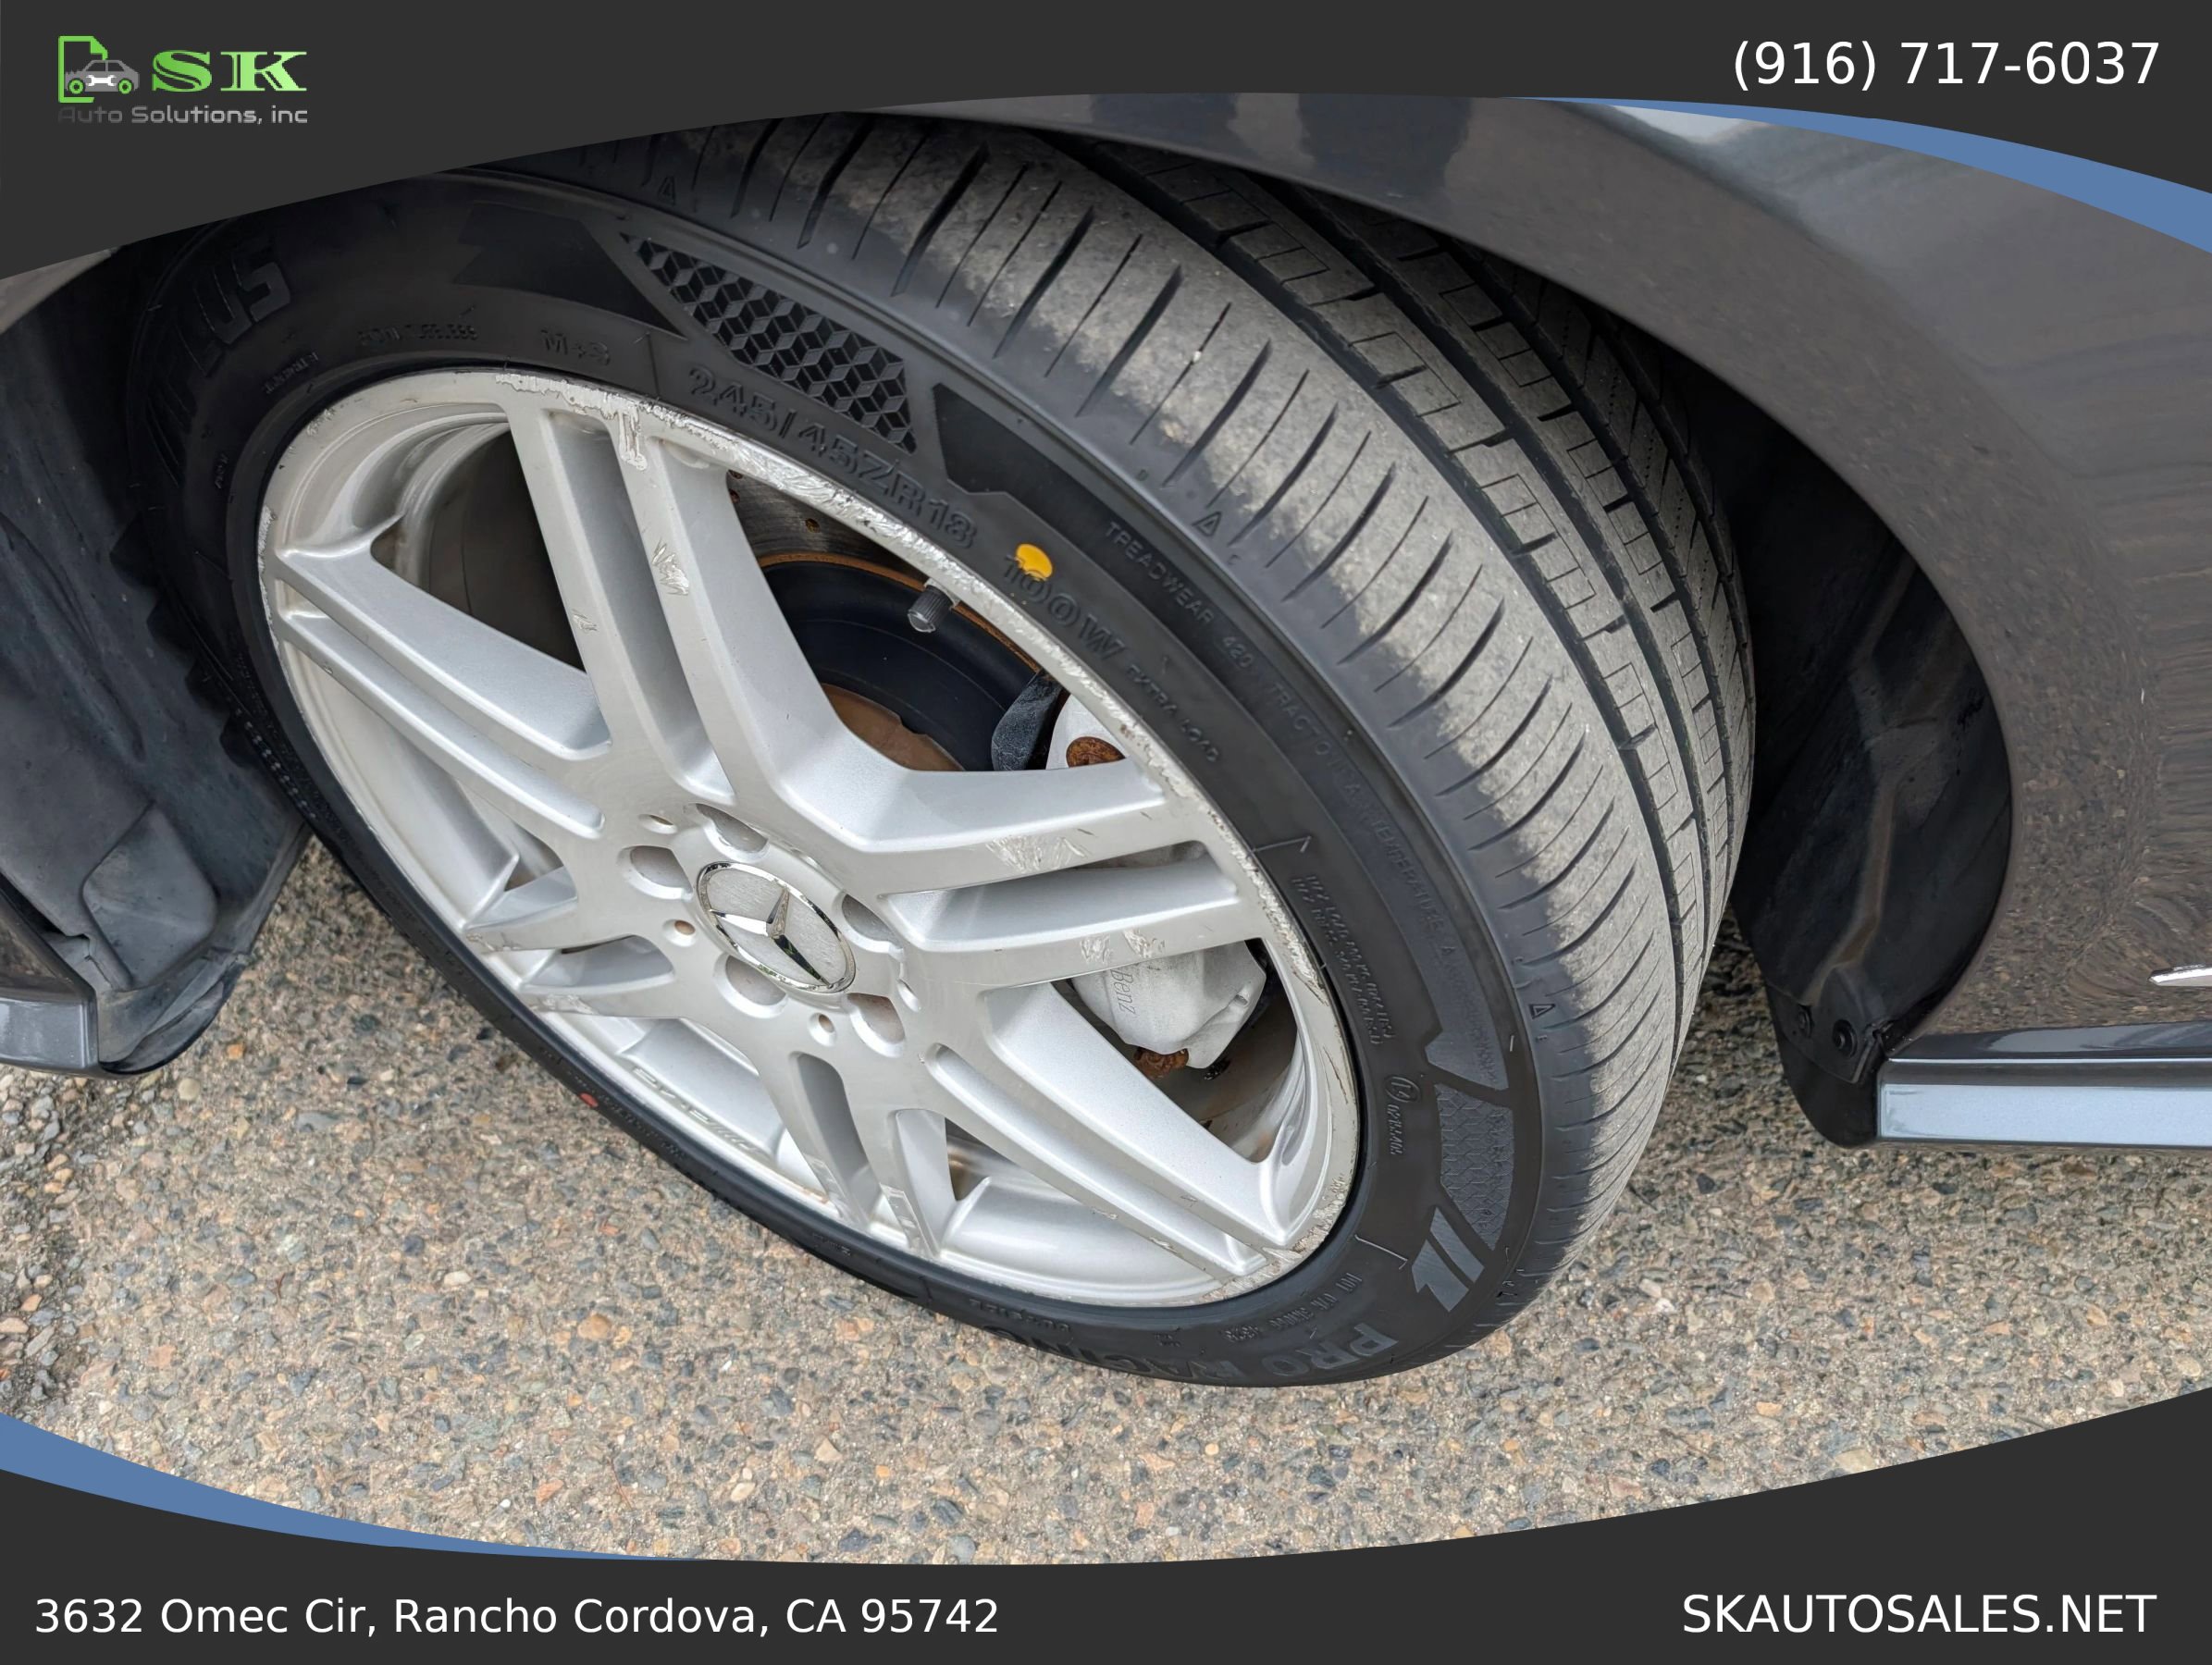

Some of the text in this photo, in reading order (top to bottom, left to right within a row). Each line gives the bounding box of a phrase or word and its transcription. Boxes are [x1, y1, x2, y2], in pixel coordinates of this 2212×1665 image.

[686, 365, 979, 549] 245/45ZR18
[1003, 553, 1126, 660] 100W
[1106, 522, 1213, 624] TREADWEAR
[1220, 635, 1254, 670] 420
[1259, 1321, 1400, 1379] PRO
